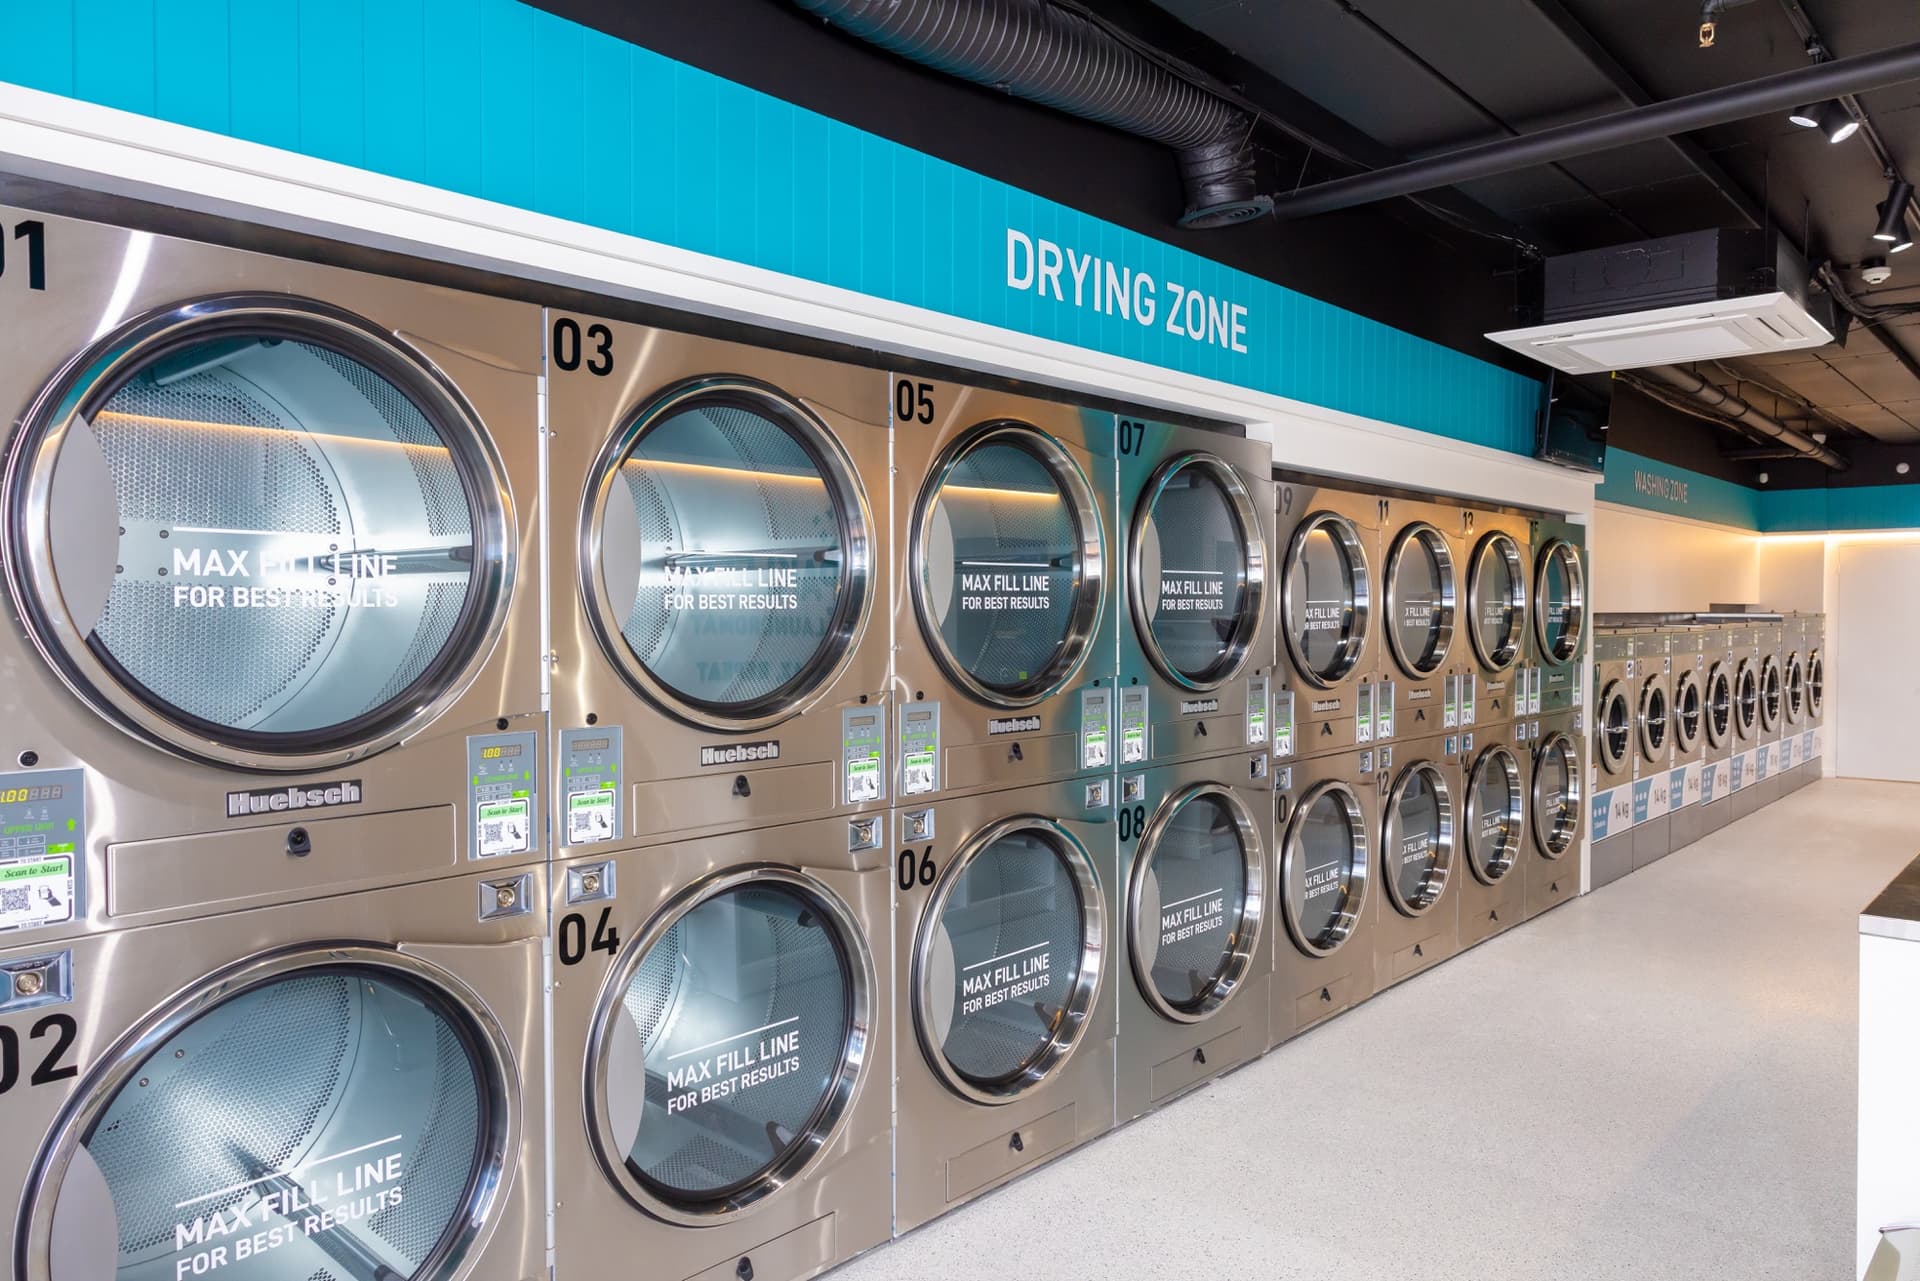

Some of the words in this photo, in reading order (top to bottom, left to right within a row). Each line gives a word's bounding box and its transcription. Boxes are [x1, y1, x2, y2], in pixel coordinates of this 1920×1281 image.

[0, 220, 46, 290] 1
[1007, 228, 1156, 327] DRYING
[1166, 281, 1248, 355] ZONE
[553, 317, 614, 377] 03
[896, 379, 935, 425] 05
[1119, 420, 1145, 457] 07
[1634, 469, 1669, 499] WASHING
[1670, 480, 1688, 504] ZONE
[173, 547, 250, 577] MAX
[664, 566, 708, 587] MAX
[758, 569, 797, 588] LINE
[173, 585, 226, 608] FOR
[962, 574, 991, 591] MAX
[994, 575, 1020, 591] FILL
[1023, 575, 1049, 591] LINE
[1162, 580, 1182, 594] MAX
[1184, 580, 1203, 595] FILL
[1204, 581, 1223, 595] LINE
[664, 594, 695, 610] FOR
[698, 594, 735, 610] BEST
[739, 594, 798, 610] RESULTS
[962, 597, 982, 610] FOR
[984, 597, 1008, 610] BEST
[1010, 596, 1050, 609] RESULTS
[1162, 599, 1176, 610] FOR
[1177, 599, 1194, 610] BEST
[1195, 599, 1223, 610] RESULTS
[1305, 608, 1314, 618] AX
[1314, 608, 1326, 618] FILL
[1327, 607, 1340, 618] LINE
[990, 716, 1040, 733] Huebsch
[702, 742, 779, 765] Huebsch
[228, 782, 360, 816] Huebsch
[1376, 770, 1389, 796] 12
[1119, 804, 1145, 842] 08
[1275, 794, 1287, 824] 0
[4, 869, 27, 878] Scan
[41, 864, 63, 873] Start
[898, 845, 936, 890] 06
[1162, 911, 1182, 931] MAX
[1184, 905, 1202, 923] FILL
[1204, 898, 1223, 916] LINE
[1162, 932, 1176, 946] FOR
[1177, 925, 1194, 941] BEST
[1195, 916, 1223, 935] RESULTS
[558, 906, 620, 966] 04
[963, 970, 992, 997] MAX
[995, 963, 1020, 986] FILL
[1024, 953, 1050, 976] LINE
[963, 997, 982, 1016] FOR
[985, 988, 1009, 1008] BEST
[1011, 974, 1050, 998] RESULTS
[667, 1059, 712, 1093] MAX
[716, 1047, 755, 1076] FILL
[760, 1030, 800, 1061] LINE
[667, 1091, 698, 1115] FOR
[701, 1077, 738, 1104] BEST
[741, 1056, 800, 1090] RESULTS
[175, 1202, 253, 1251] MAX
[261, 1180, 329, 1222] FILL
[337, 1152, 402, 1196] LINE
[176, 1245, 228, 1281] FOR
[235, 1221, 299, 1262] BEST
[304, 1186, 404, 1238] RESULTS
